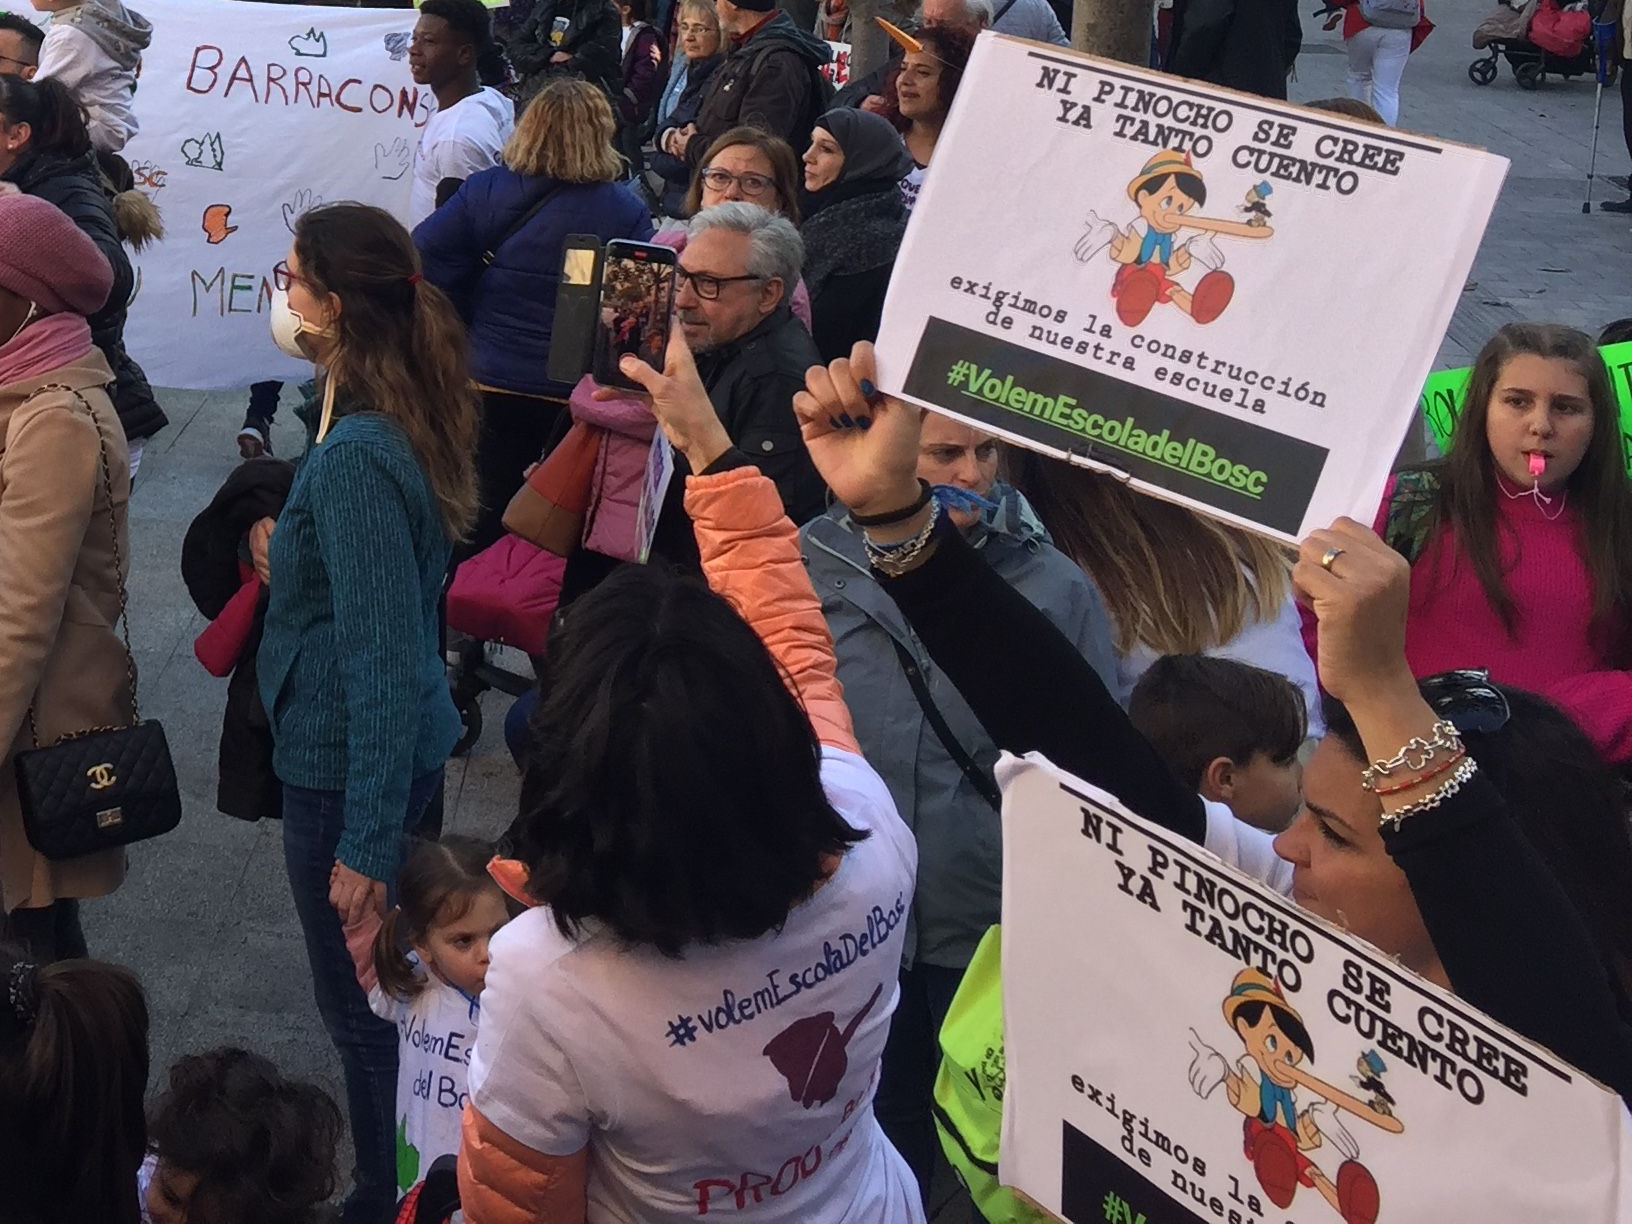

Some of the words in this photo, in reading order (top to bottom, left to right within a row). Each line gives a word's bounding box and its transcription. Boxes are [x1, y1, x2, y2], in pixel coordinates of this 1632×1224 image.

[186, 44, 434, 128] BARRACONS
[1035, 65, 1078, 97] NI
[1092, 79, 1235, 134] PINOCHO
[1252, 119, 1298, 150] SE
[1315, 134, 1407, 177] CREE
[1056, 99, 1094, 130] YA
[1112, 114, 1215, 160] TANTO
[1232, 145, 1360, 196] CUENTO
[190, 266, 273, 317] MEN
[949, 274, 1069, 325] exigimos
[1082, 315, 1113, 340] la
[1130, 332, 1328, 410] construcción
[985, 305, 1015, 330] de
[1027, 325, 1136, 373] nuestra
[1154, 364, 1267, 415] escuela
[947, 359, 1268, 497] #VolemEscoladelBosc
[1079, 807, 1124, 856] NI
[1147, 844, 1315, 964] PINOCHO
[1342, 960, 1392, 1015] SE
[1416, 1005, 1529, 1098] CREE
[1114, 859, 1162, 913] YA
[1181, 903, 1302, 993] TANTO
[1326, 988, 1485, 1105] CUENTO
[413, 1069, 434, 1101] del
[1070, 1074, 1207, 1178] exigimos
[1227, 1175, 1265, 1218] la
[1120, 1128, 1153, 1168] de
